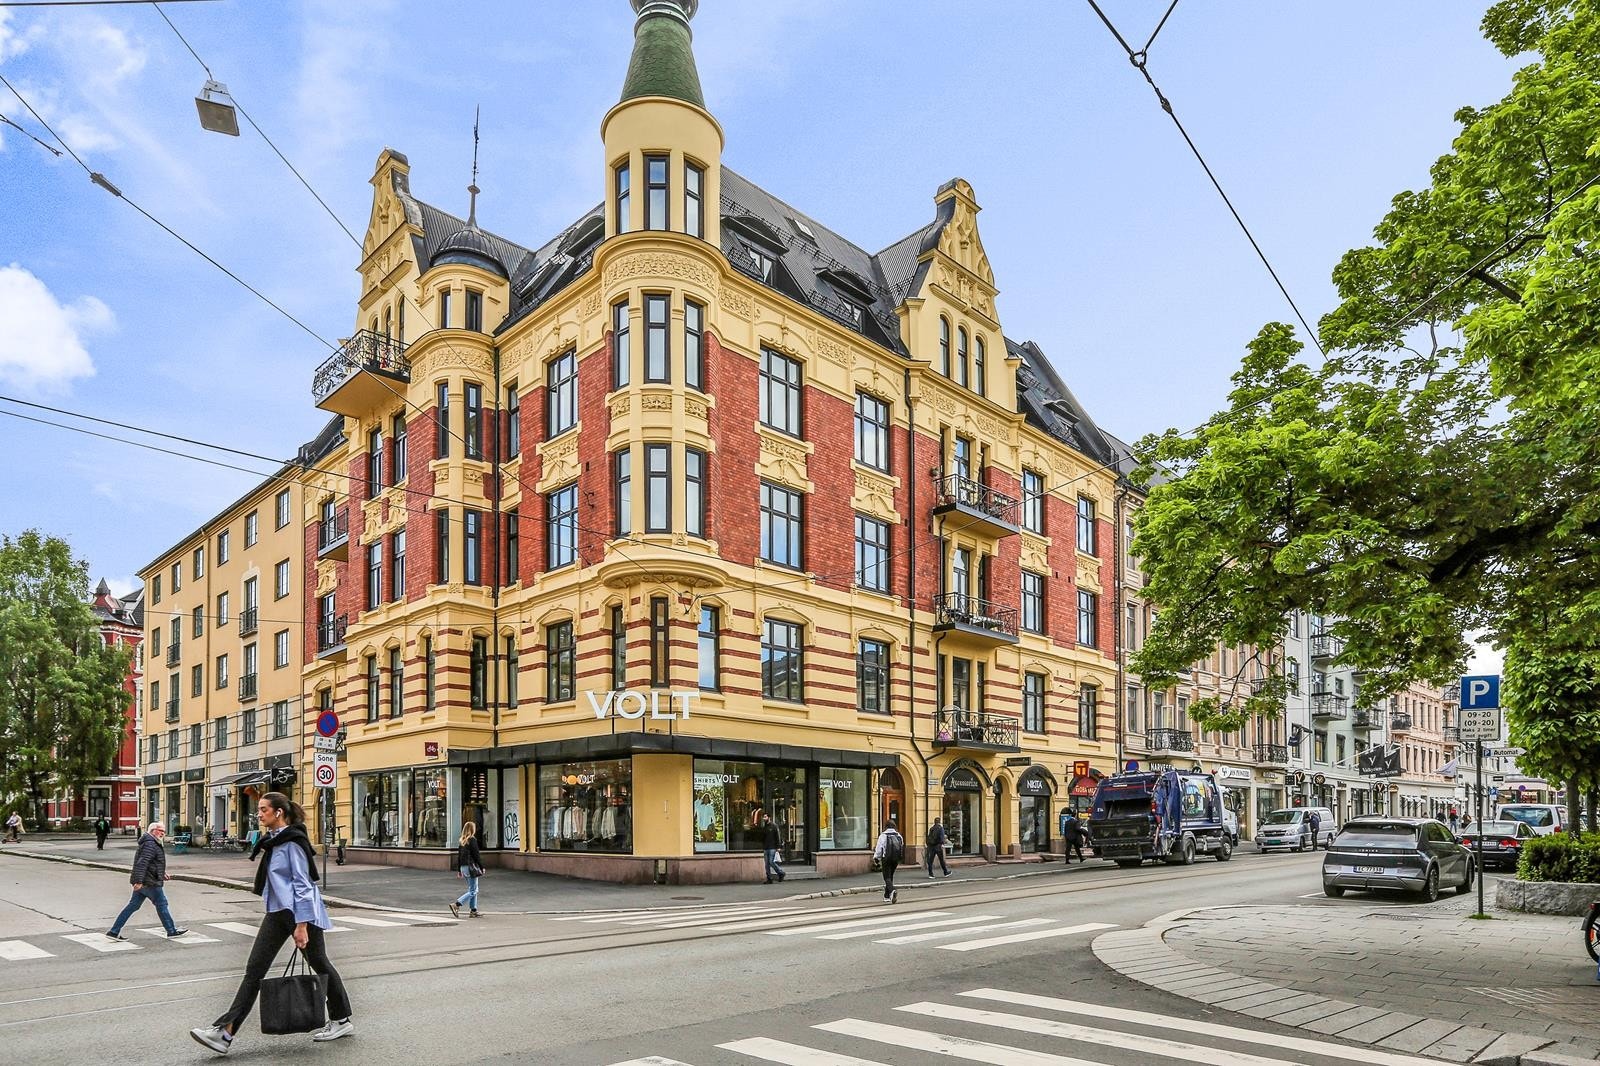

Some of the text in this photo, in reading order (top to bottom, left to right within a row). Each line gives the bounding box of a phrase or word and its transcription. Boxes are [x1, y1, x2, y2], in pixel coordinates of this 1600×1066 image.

[1469, 680, 1490, 706] P
[585, 690, 701, 720] VOLT
[320, 769, 332, 780] 30
[578, 774, 595, 784] VOLT
[716, 774, 740, 784] VOLT
[428, 780, 440, 788] VOLT
[833, 780, 852, 788] VOLT
